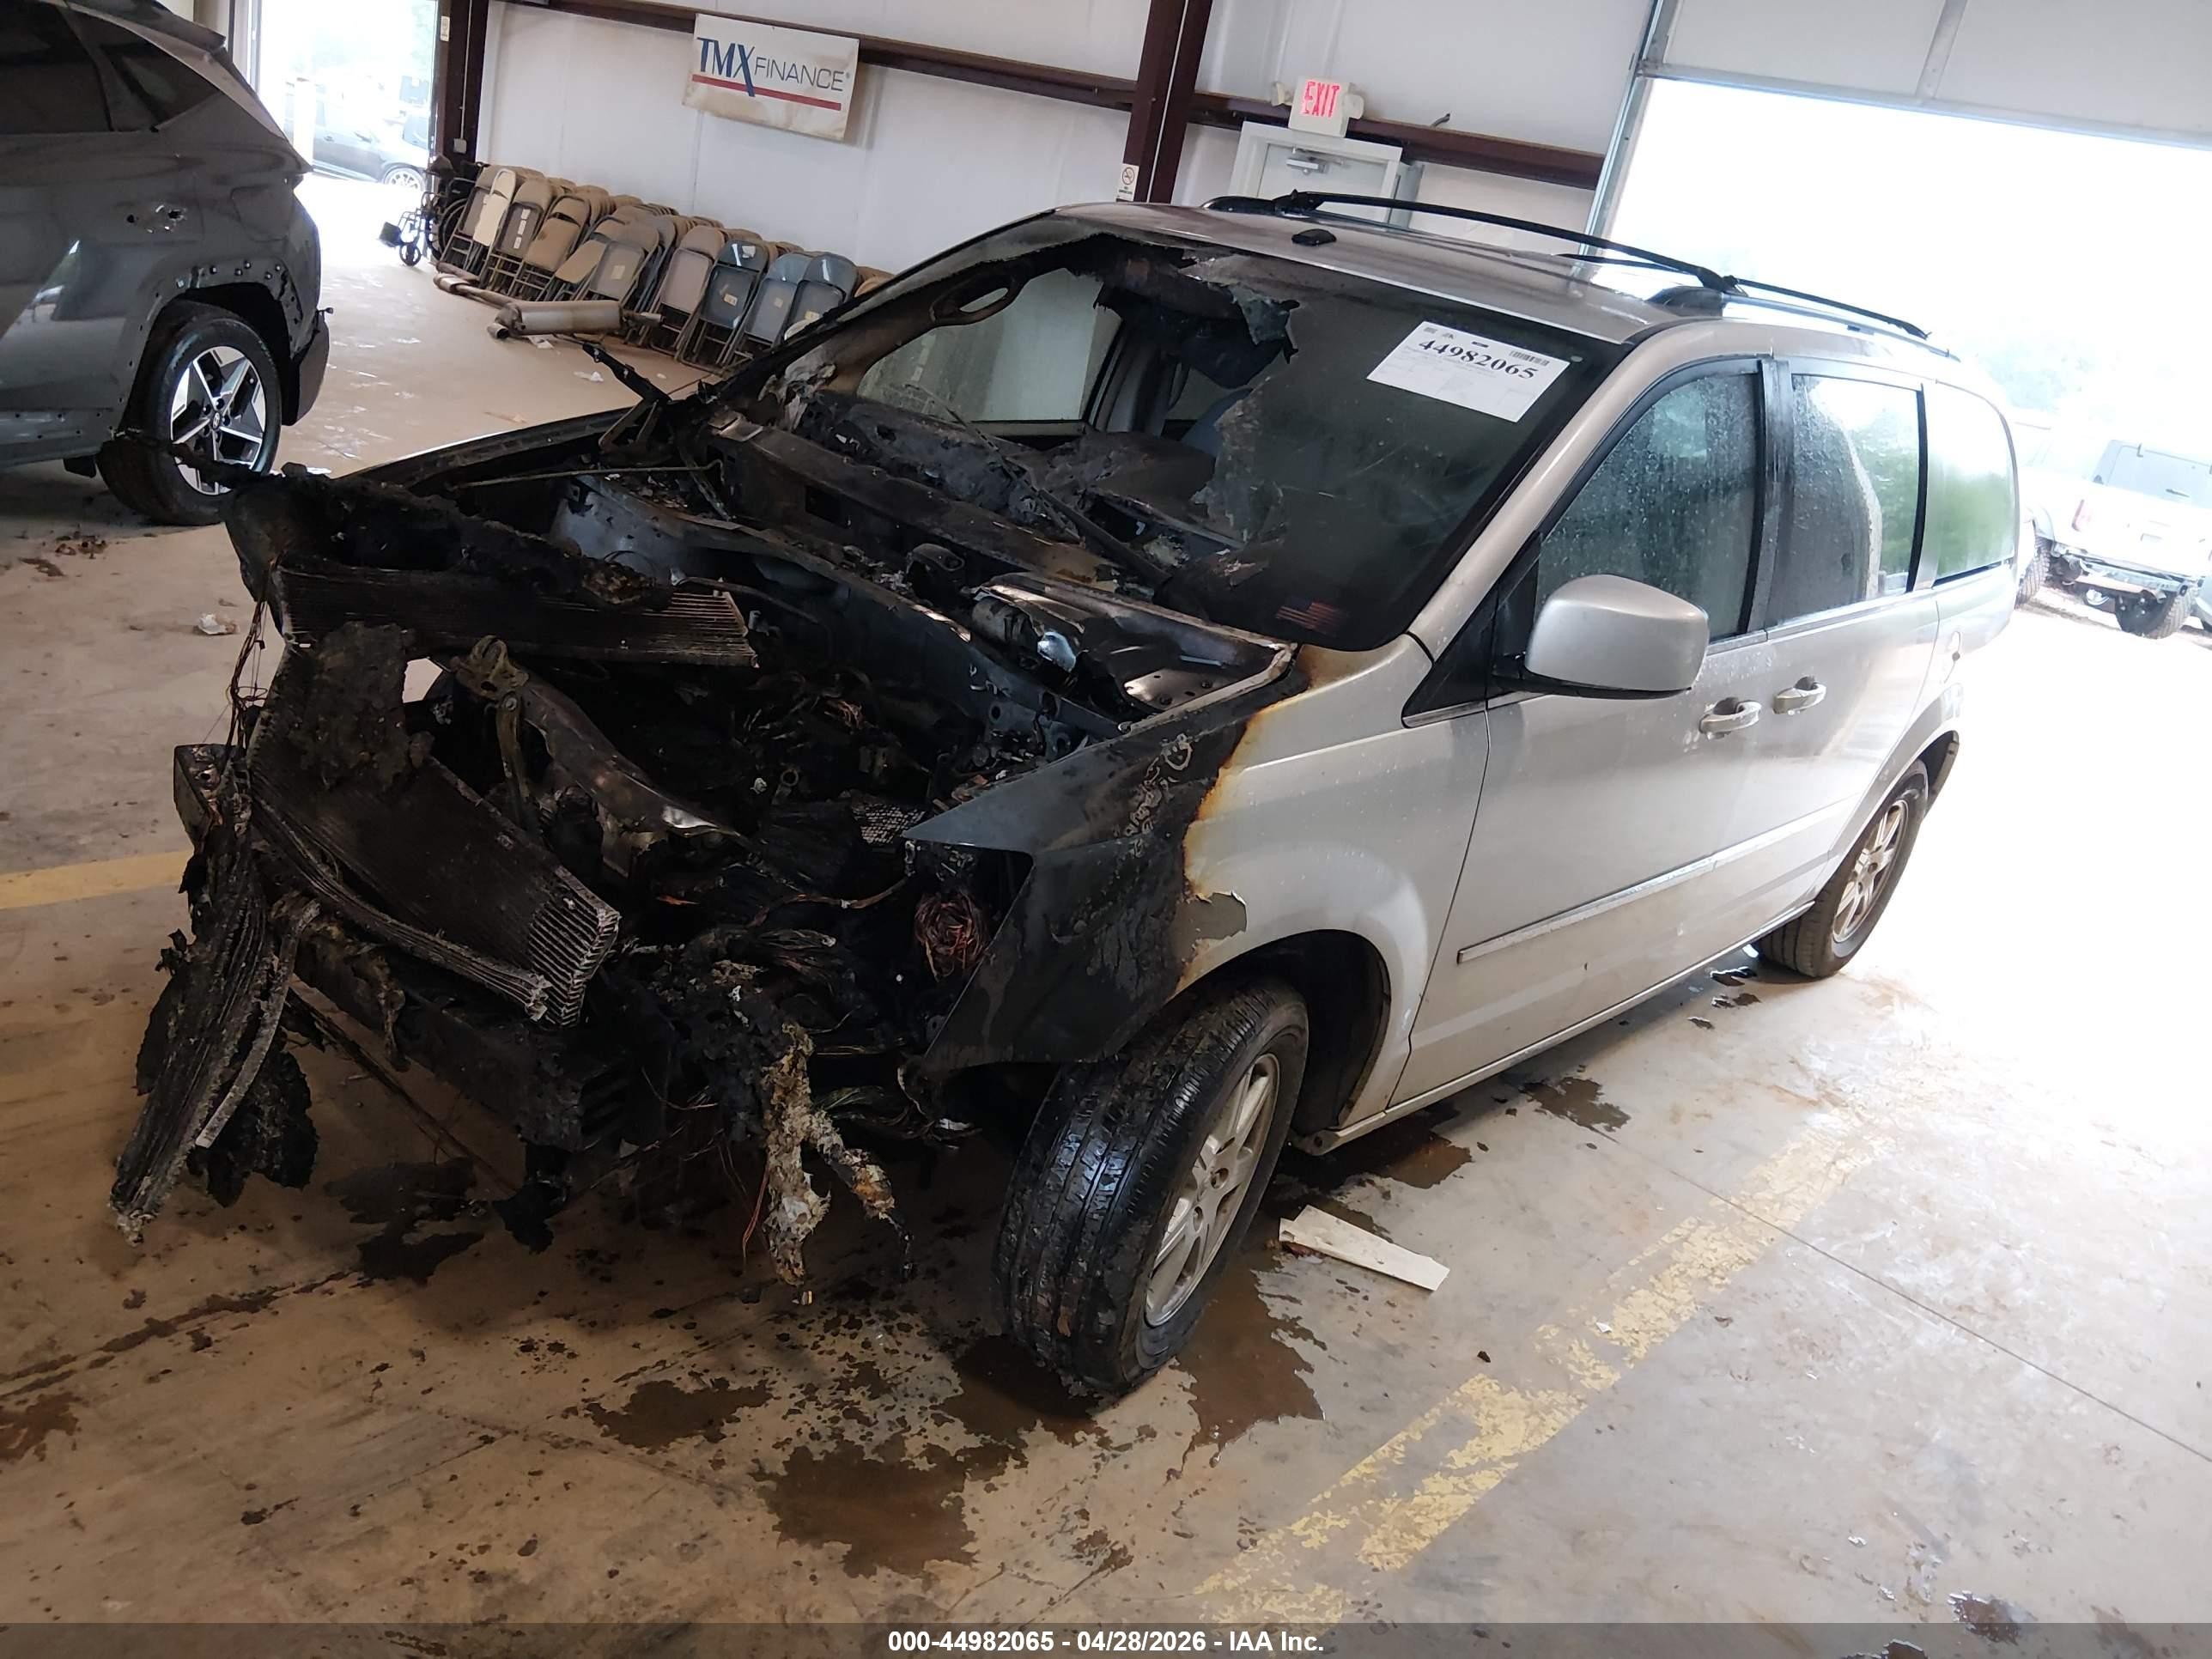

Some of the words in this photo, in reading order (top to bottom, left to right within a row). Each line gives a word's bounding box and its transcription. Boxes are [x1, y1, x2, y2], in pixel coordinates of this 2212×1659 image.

[696, 37, 756, 97] TMX
[754, 57, 844, 92] FINANCE
[1300, 80, 1340, 118] EXIT
[1419, 340, 1539, 379] 44982065
